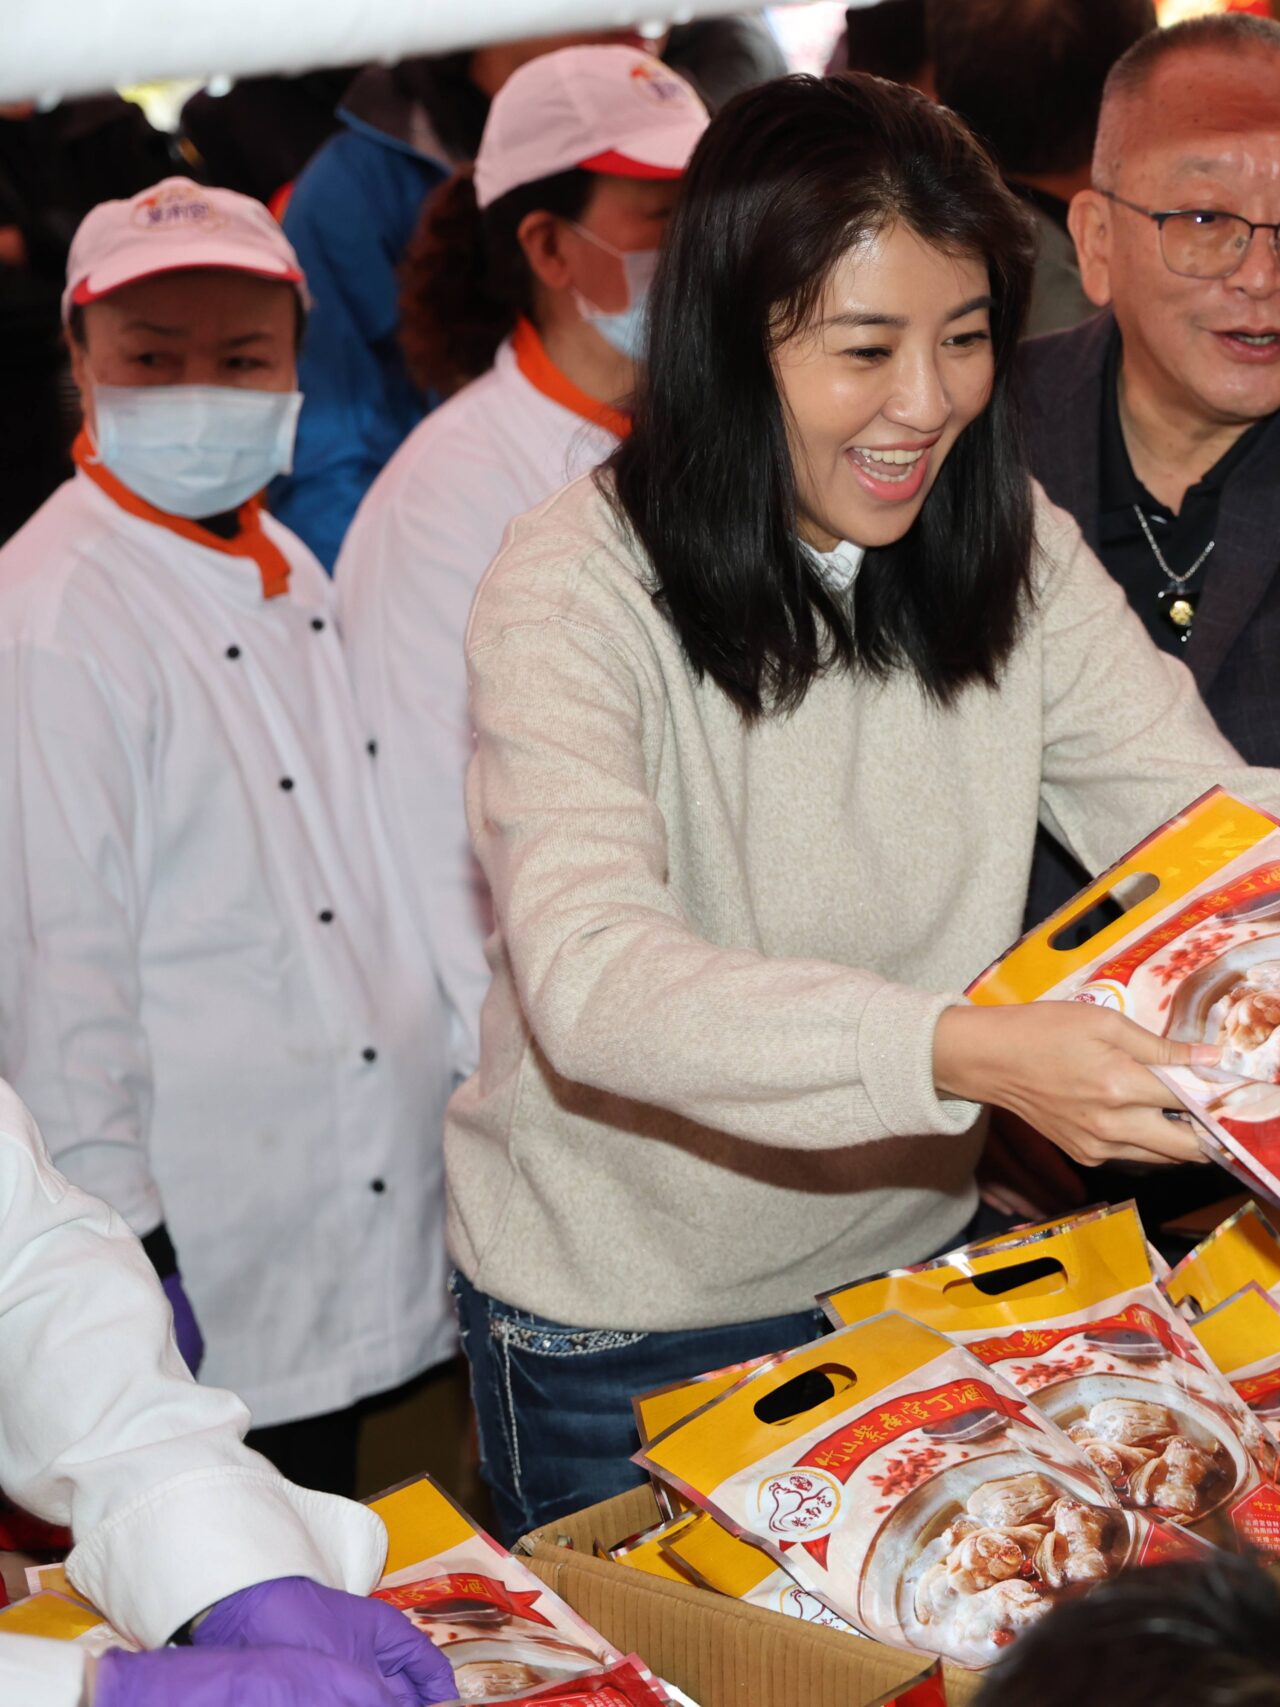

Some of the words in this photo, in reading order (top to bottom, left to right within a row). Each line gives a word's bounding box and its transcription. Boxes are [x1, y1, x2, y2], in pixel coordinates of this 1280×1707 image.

[814, 1383, 988, 1470] 竹山紫南宮丁酒
